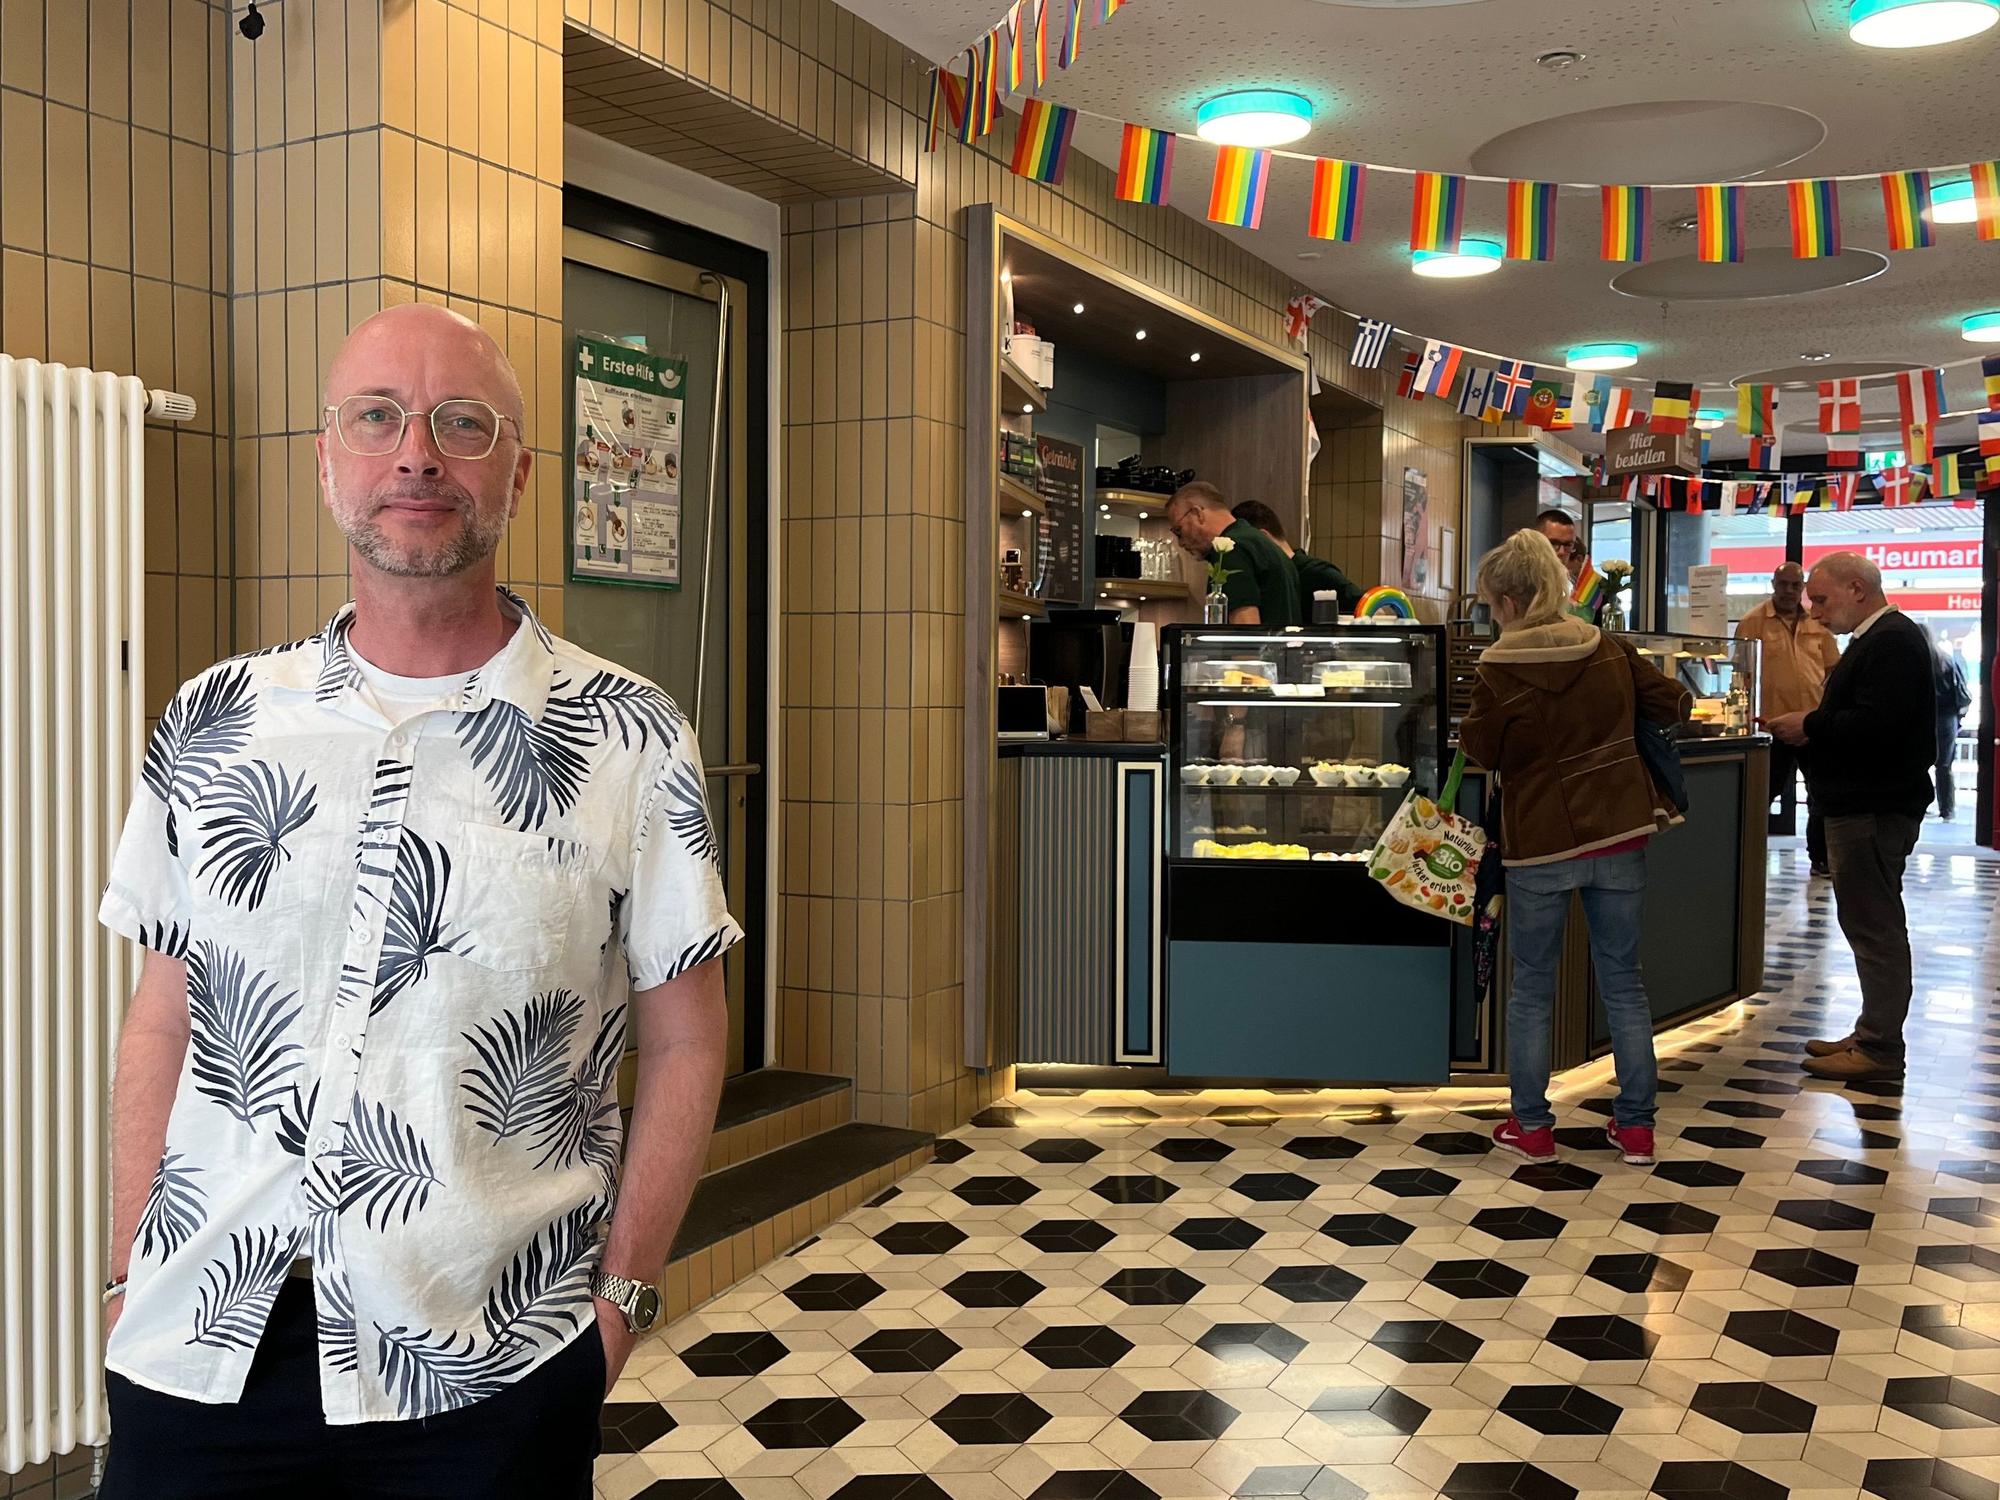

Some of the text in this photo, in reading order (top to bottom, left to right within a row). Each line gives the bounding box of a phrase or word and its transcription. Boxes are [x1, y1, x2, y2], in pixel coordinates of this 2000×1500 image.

[602, 356, 635, 376] Erste
[1628, 432, 1656, 450] Hier
[1615, 450, 1666, 469] bestellen
[1434, 848, 1463, 872] Bio
[1411, 859, 1430, 883] lecker
[1429, 882, 1463, 894] erleben
